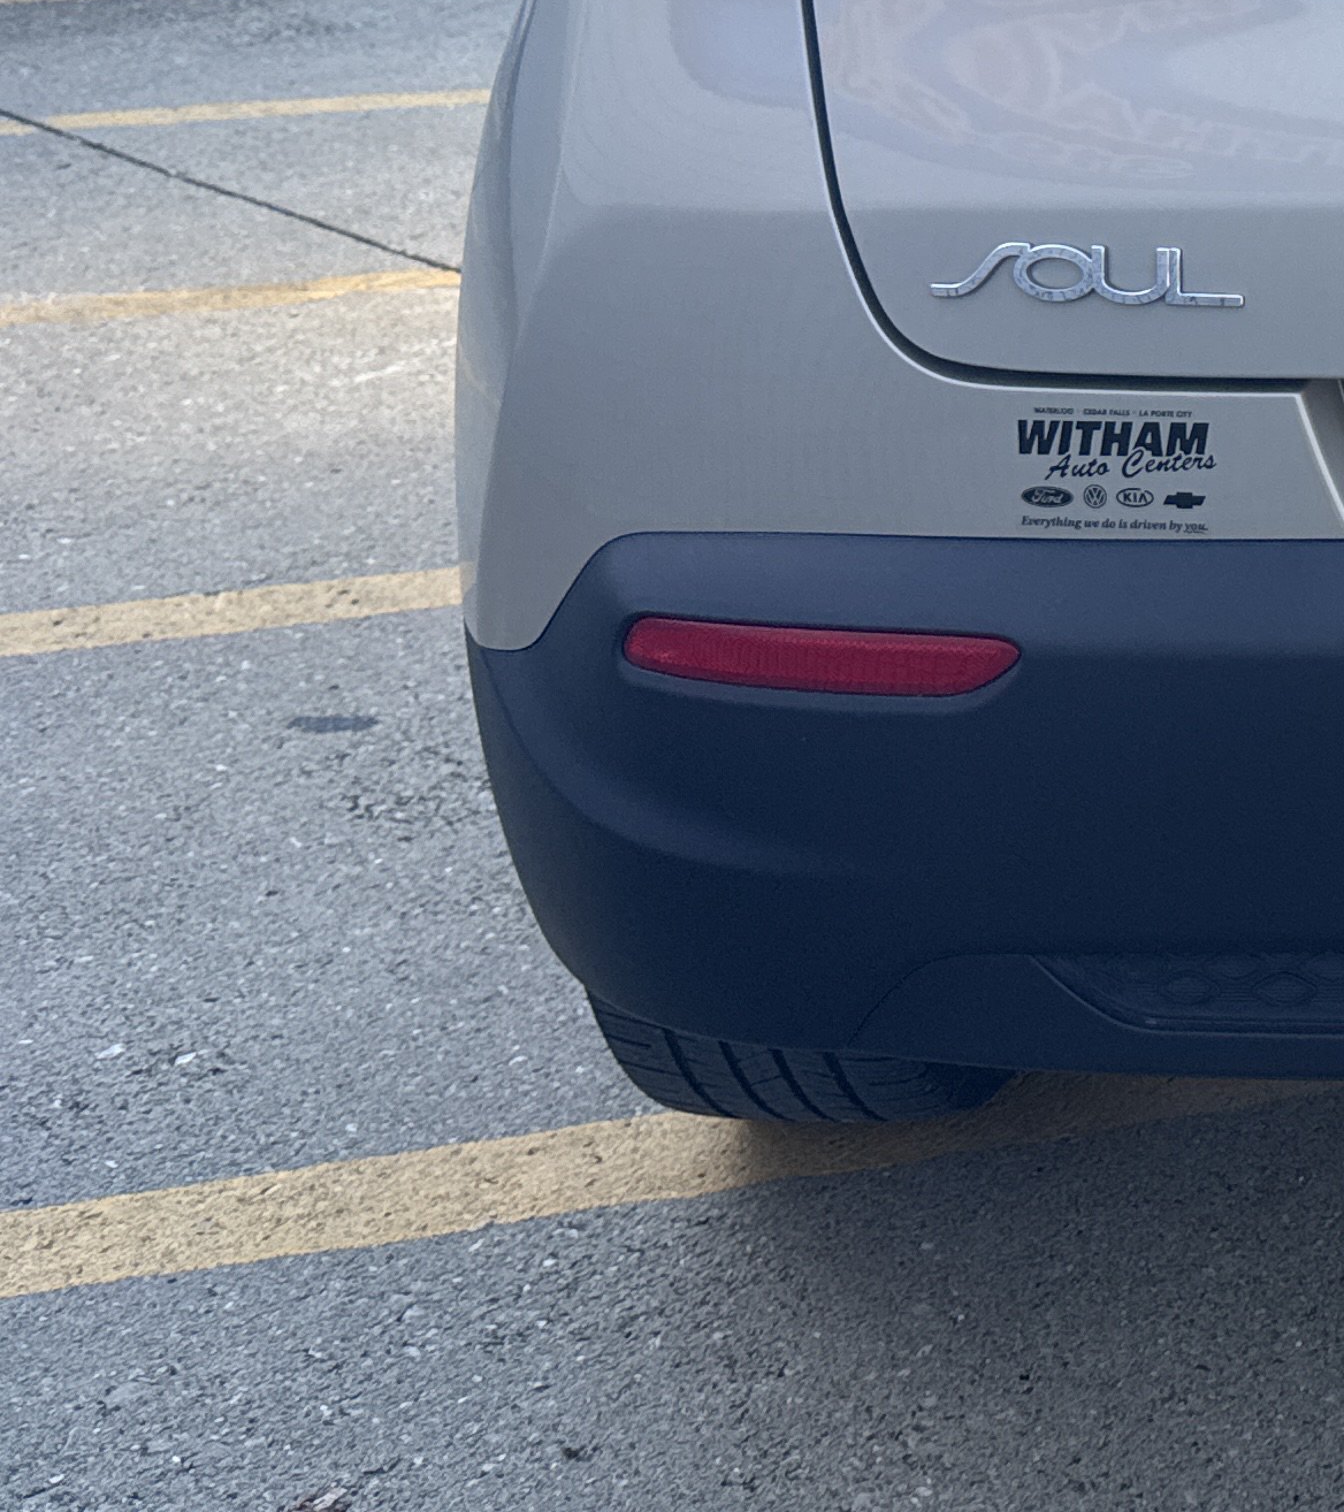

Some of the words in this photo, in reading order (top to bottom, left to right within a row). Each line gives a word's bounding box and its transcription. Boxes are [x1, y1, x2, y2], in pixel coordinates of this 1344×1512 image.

[930, 242, 1245, 306] SOUL
[1017, 419, 1209, 457] WITHAM
[1045, 453, 1110, 481] Auto
[1122, 449, 1217, 478] Centers
[1021, 515, 1082, 530] Everything
[1084, 519, 1100, 529] we
[1101, 518, 1116, 529] do
[1119, 518, 1128, 529] is
[1129, 518, 1166, 530] driven
[1169, 519, 1182, 533] by
